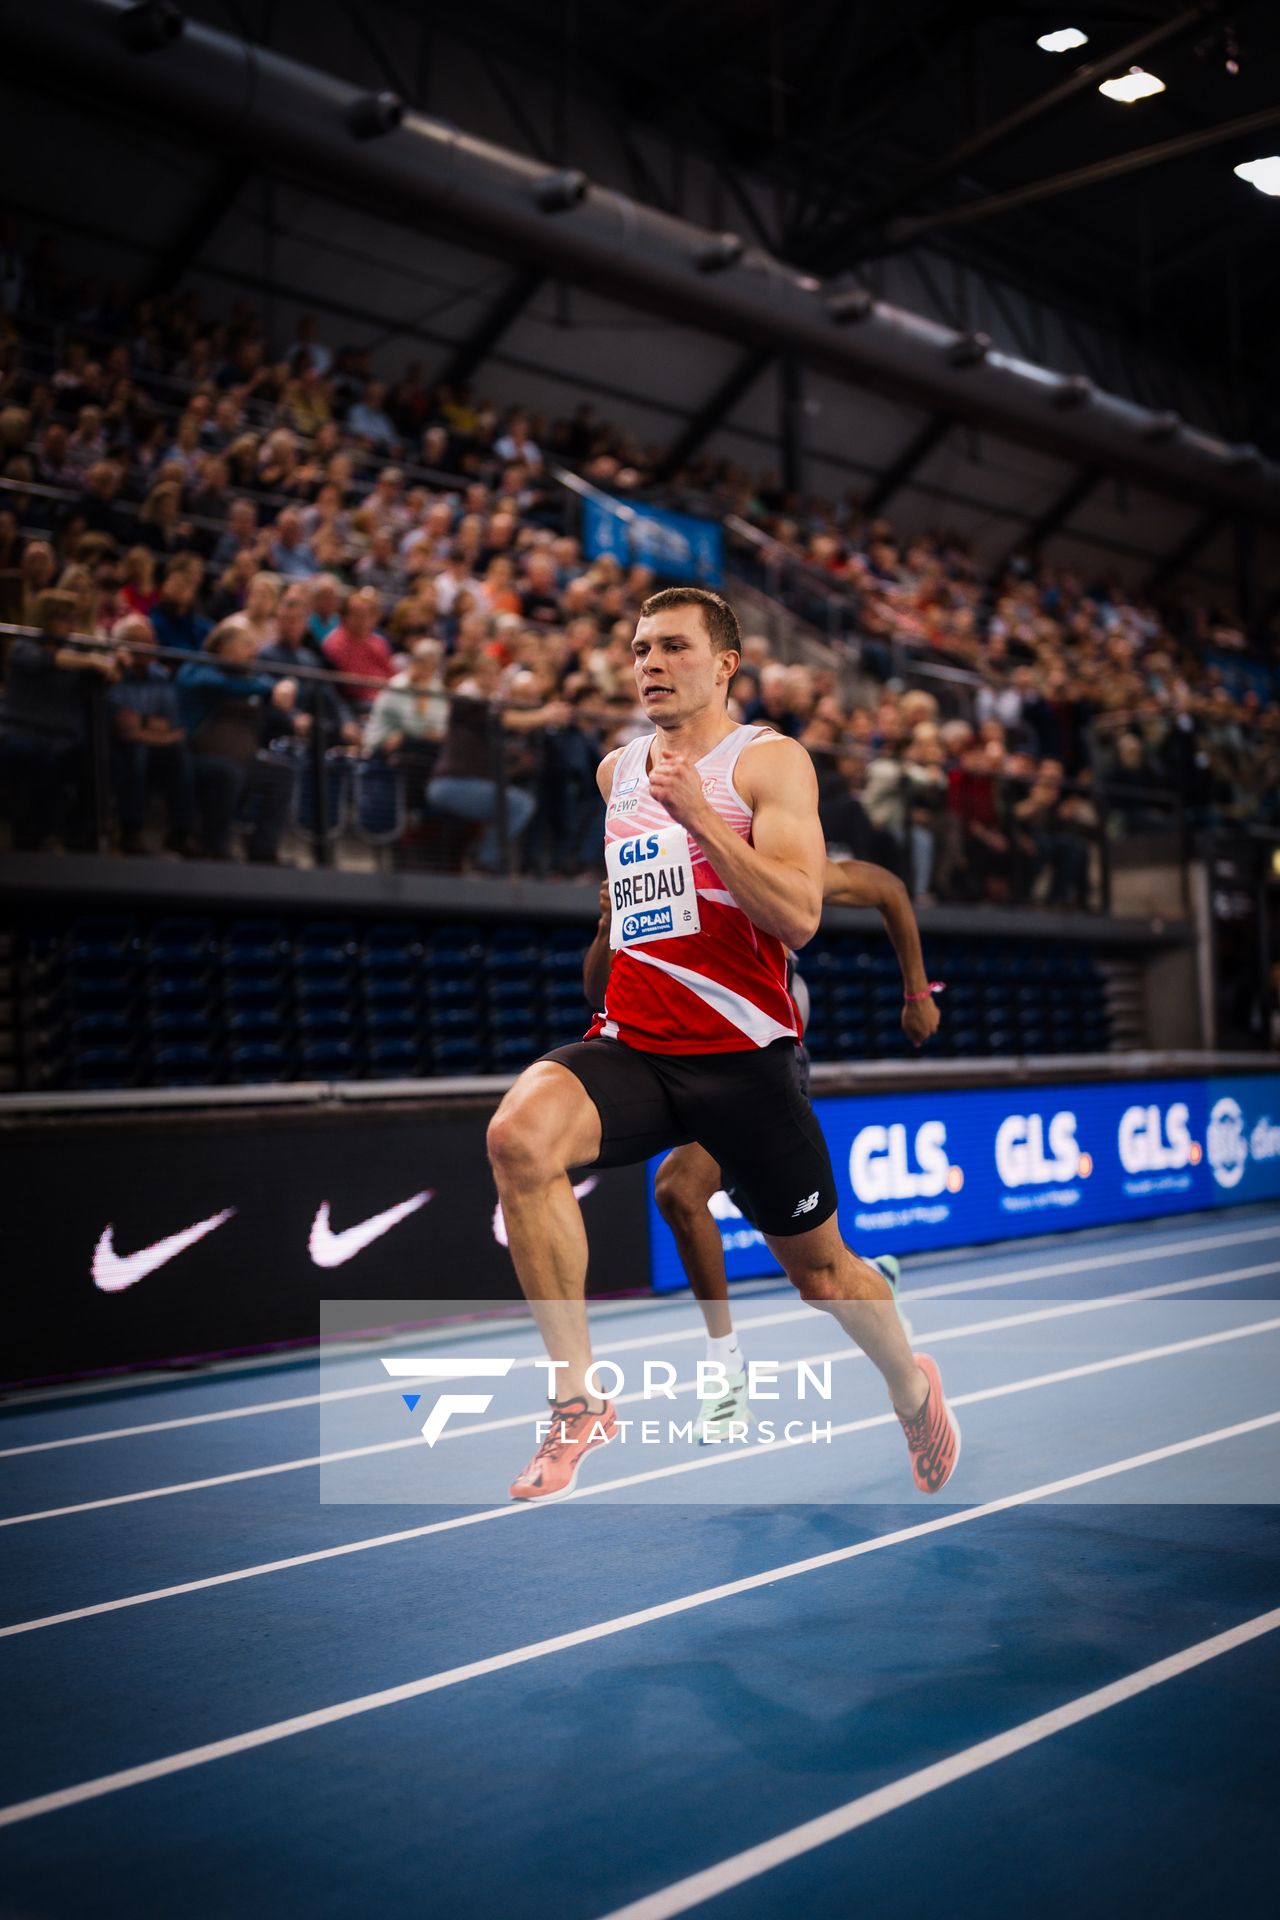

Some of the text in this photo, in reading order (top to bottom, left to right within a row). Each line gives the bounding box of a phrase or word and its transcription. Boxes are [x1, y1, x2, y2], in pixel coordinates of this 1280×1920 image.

[616, 799, 638, 813] EWP
[614, 865, 685, 911] BREDAU
[640, 911, 671, 928] PLAN
